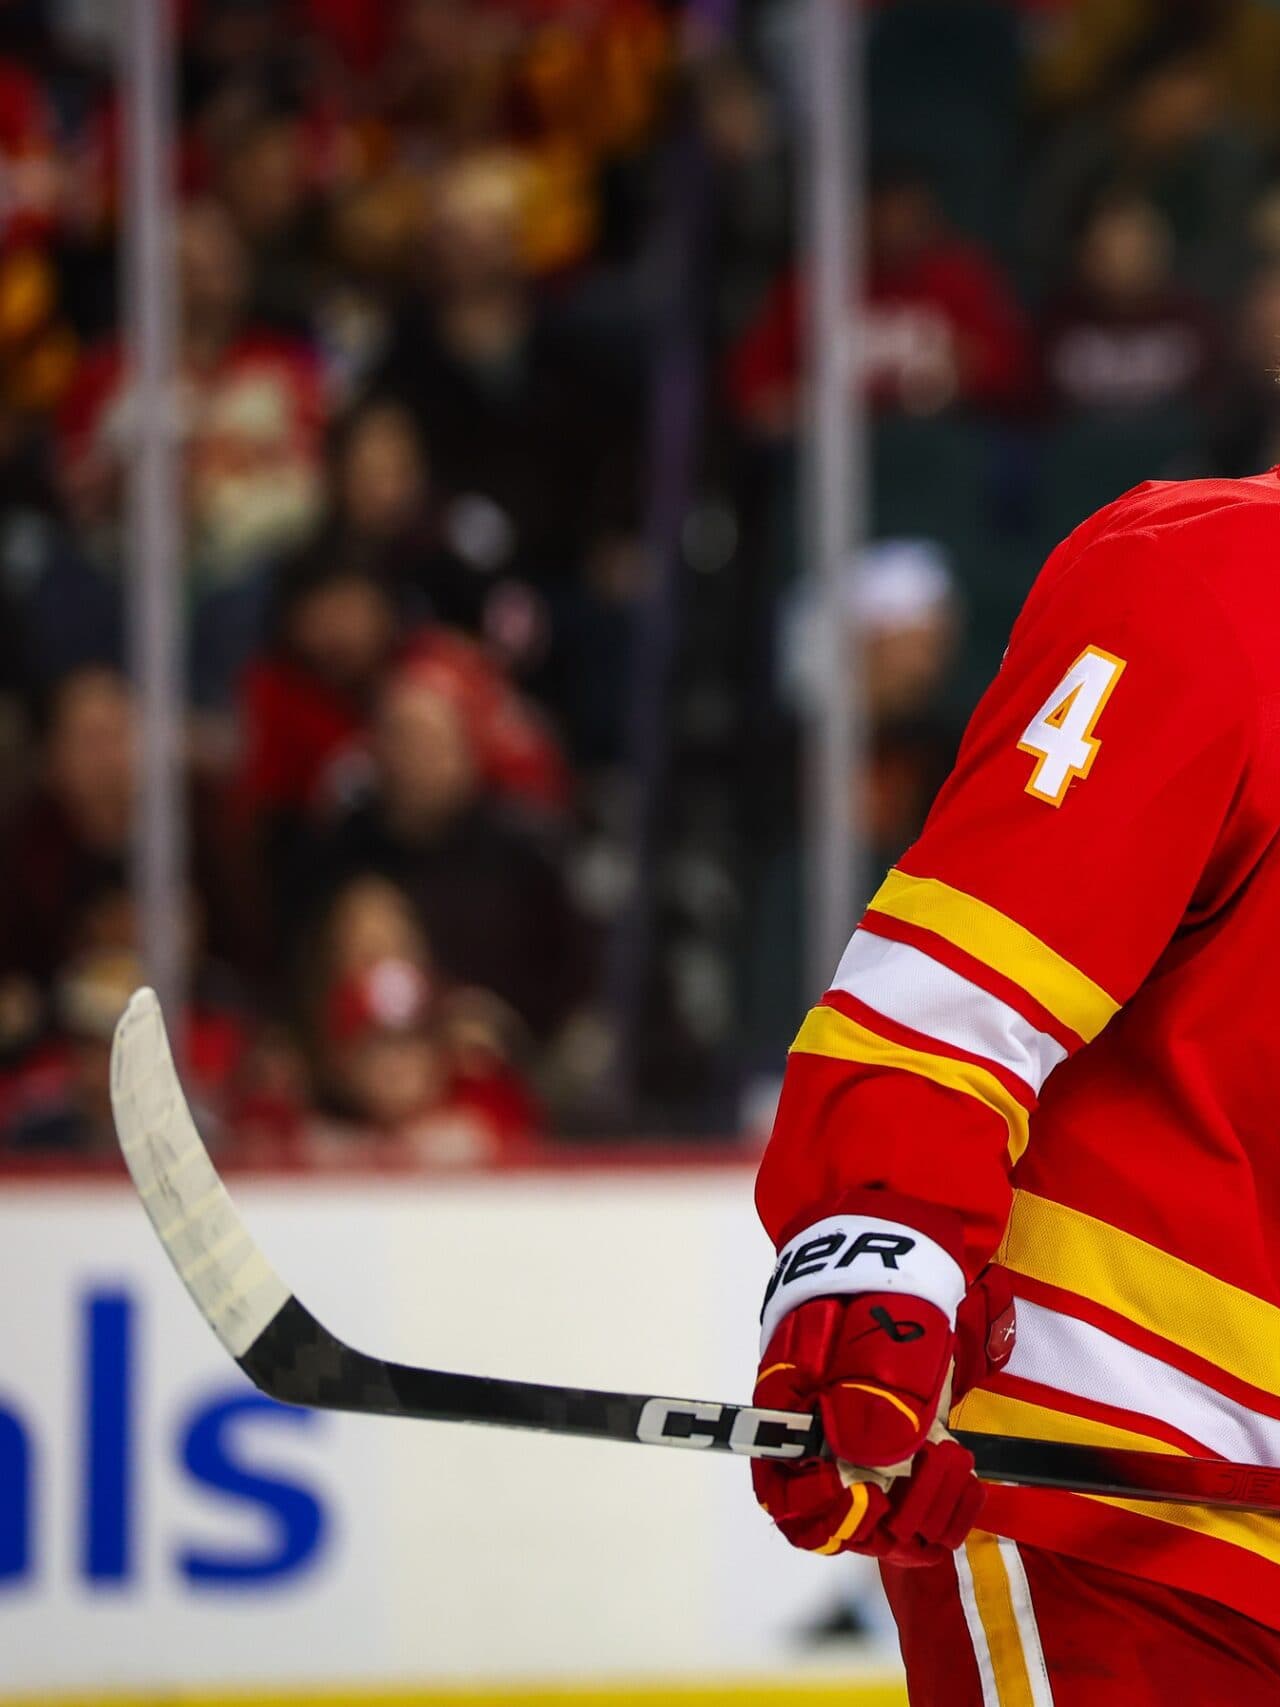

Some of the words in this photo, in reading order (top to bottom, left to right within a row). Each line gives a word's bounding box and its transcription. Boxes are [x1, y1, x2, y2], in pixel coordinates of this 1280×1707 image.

[1016, 643, 1128, 809] 4
[0, 1282, 332, 1592] ls
[636, 1398, 814, 1459] CC
